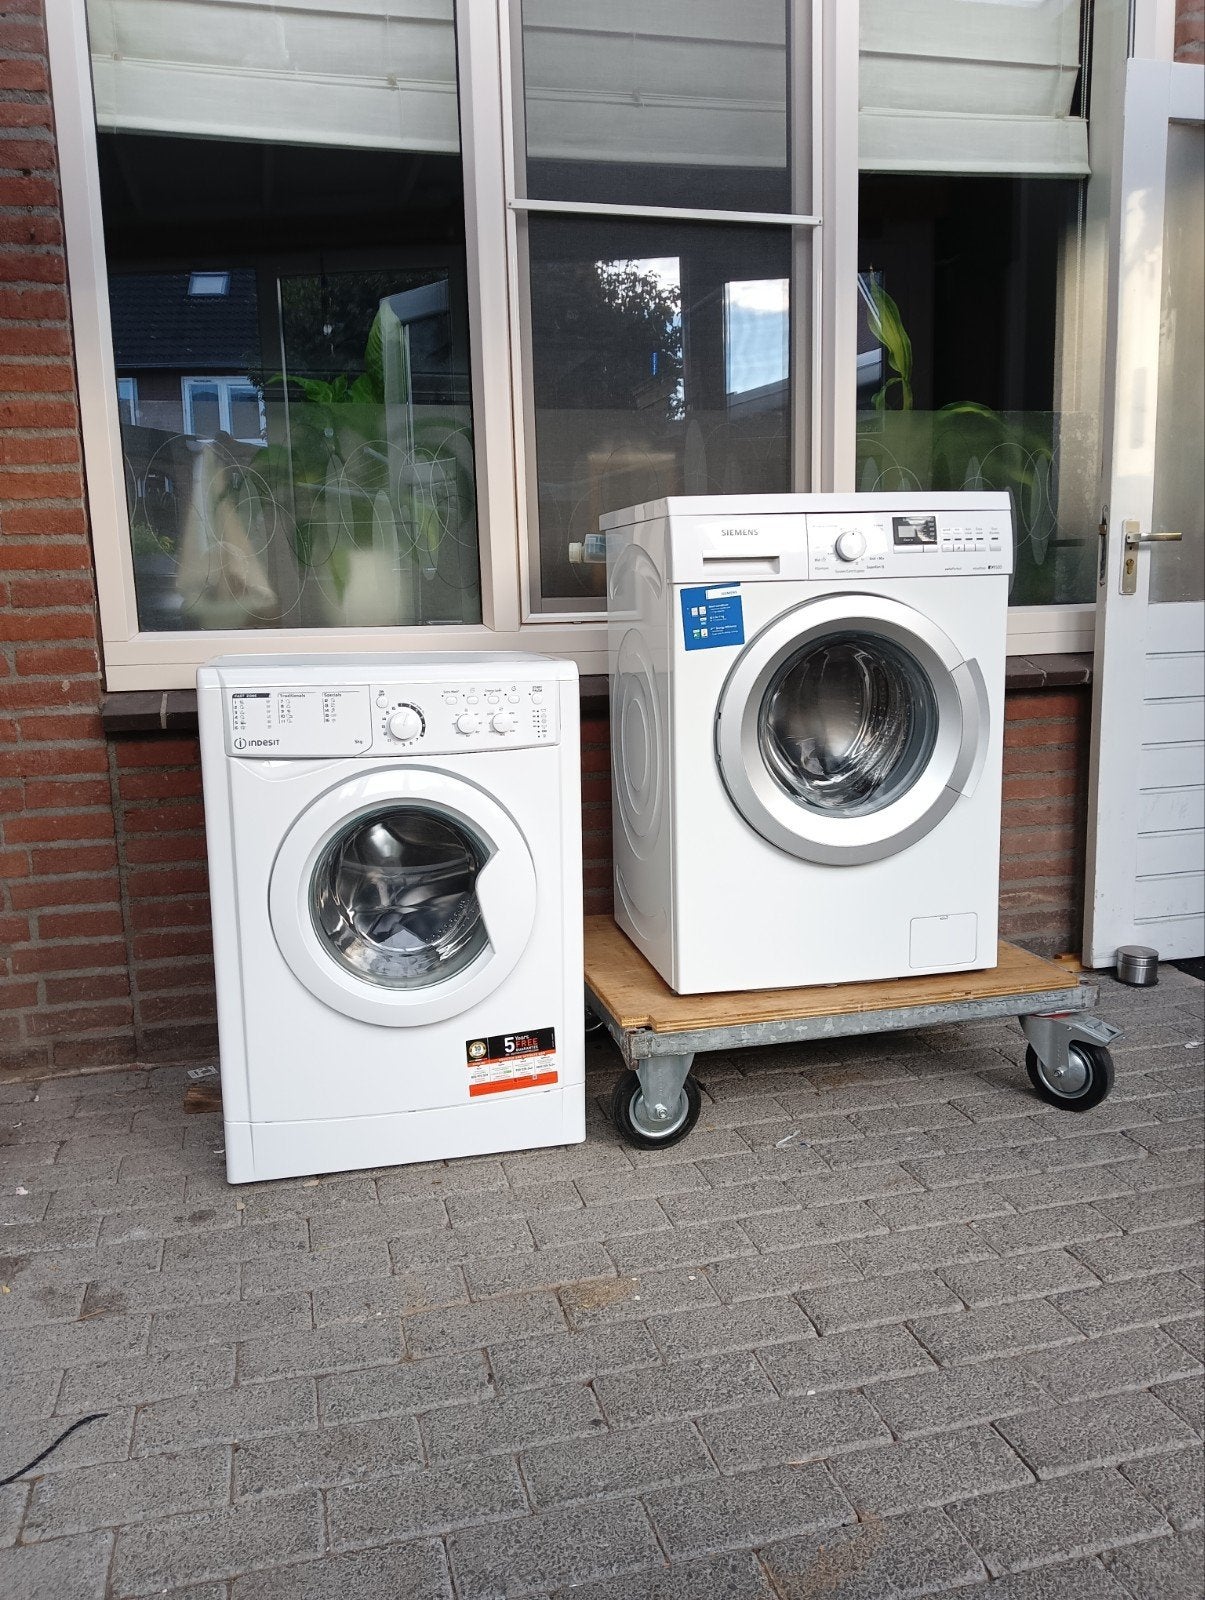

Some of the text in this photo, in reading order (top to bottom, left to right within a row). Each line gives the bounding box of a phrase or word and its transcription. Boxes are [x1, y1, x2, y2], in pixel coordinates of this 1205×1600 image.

[721, 529, 759, 537] SIEMENS
[248, 739, 280, 747] INDESIT
[504, 1036, 515, 1053] 5
[515, 1038, 538, 1048] FREE
